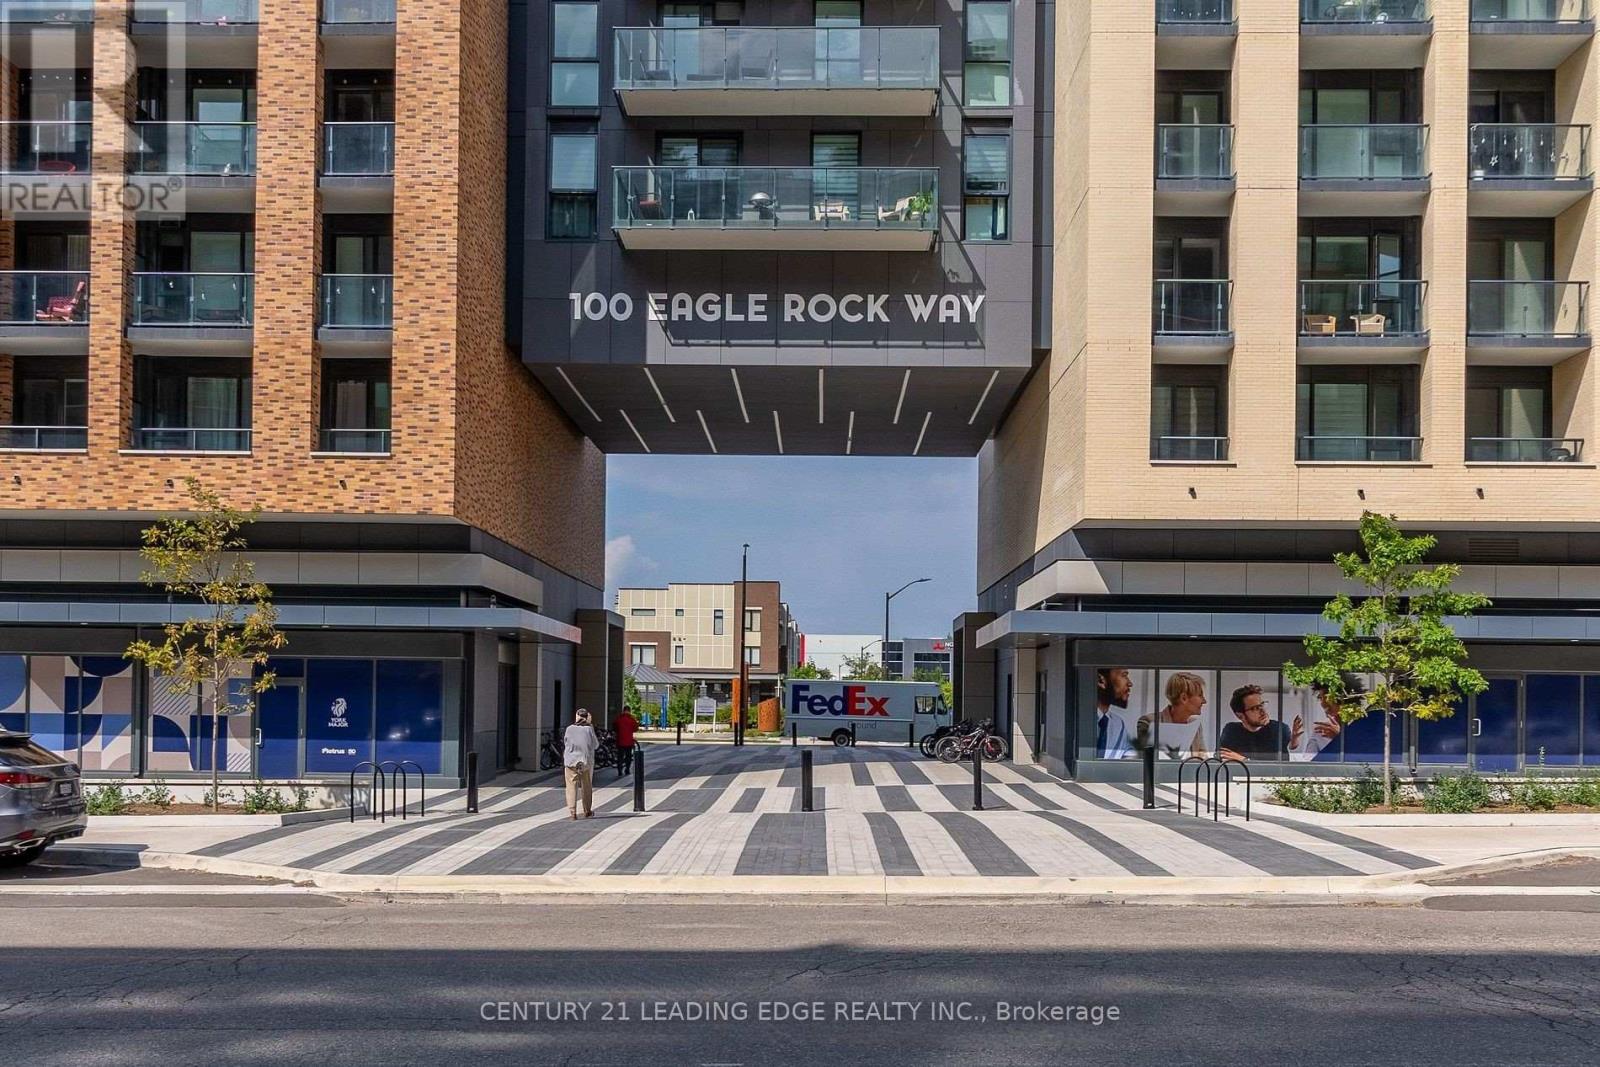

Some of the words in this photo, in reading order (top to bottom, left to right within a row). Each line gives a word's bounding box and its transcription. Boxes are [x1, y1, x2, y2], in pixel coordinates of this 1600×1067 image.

[569, 292, 633, 322] 100
[648, 292, 768, 322] EAGLE
[784, 293, 891, 323] ROCK
[904, 294, 986, 323] WAY
[791, 684, 890, 717] FedEx
[847, 720, 877, 729] Gound
